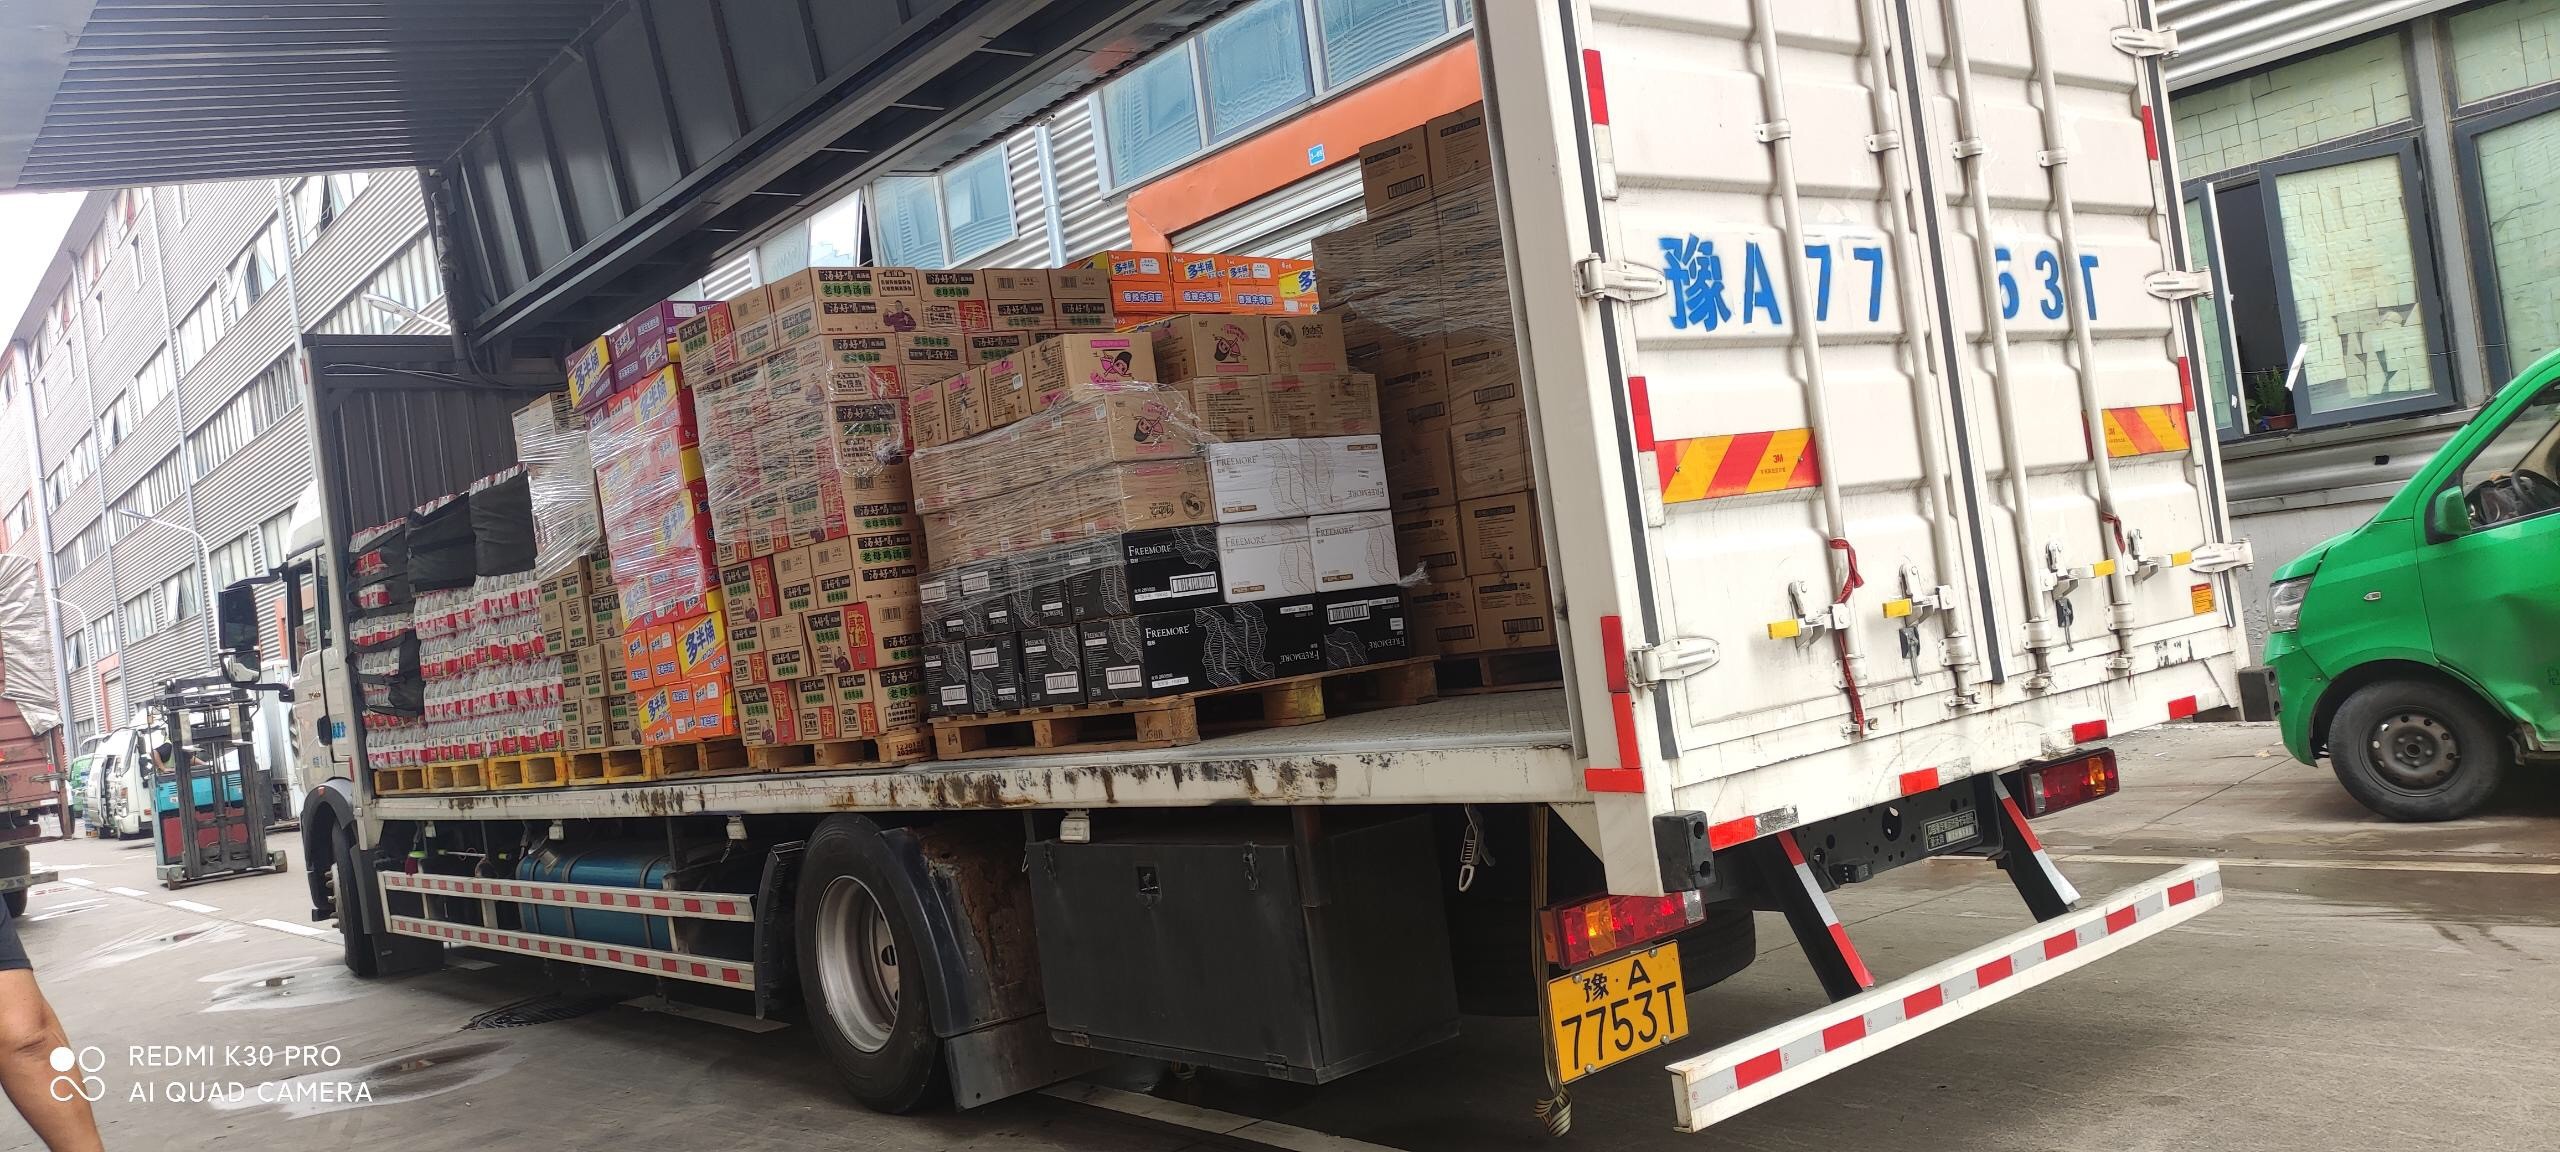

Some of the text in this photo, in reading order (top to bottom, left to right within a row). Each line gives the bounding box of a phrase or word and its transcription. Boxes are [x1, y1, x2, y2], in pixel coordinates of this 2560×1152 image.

[1216, 455, 1258, 466] FREEMORE
[1315, 526, 1353, 538] FREEMORE
[1225, 535, 1265, 548] FREEMORE
[1128, 542, 1173, 557] FREEMORE
[1145, 624, 1190, 638] FREEMORE
[1561, 981, 1677, 1070] 7753T
